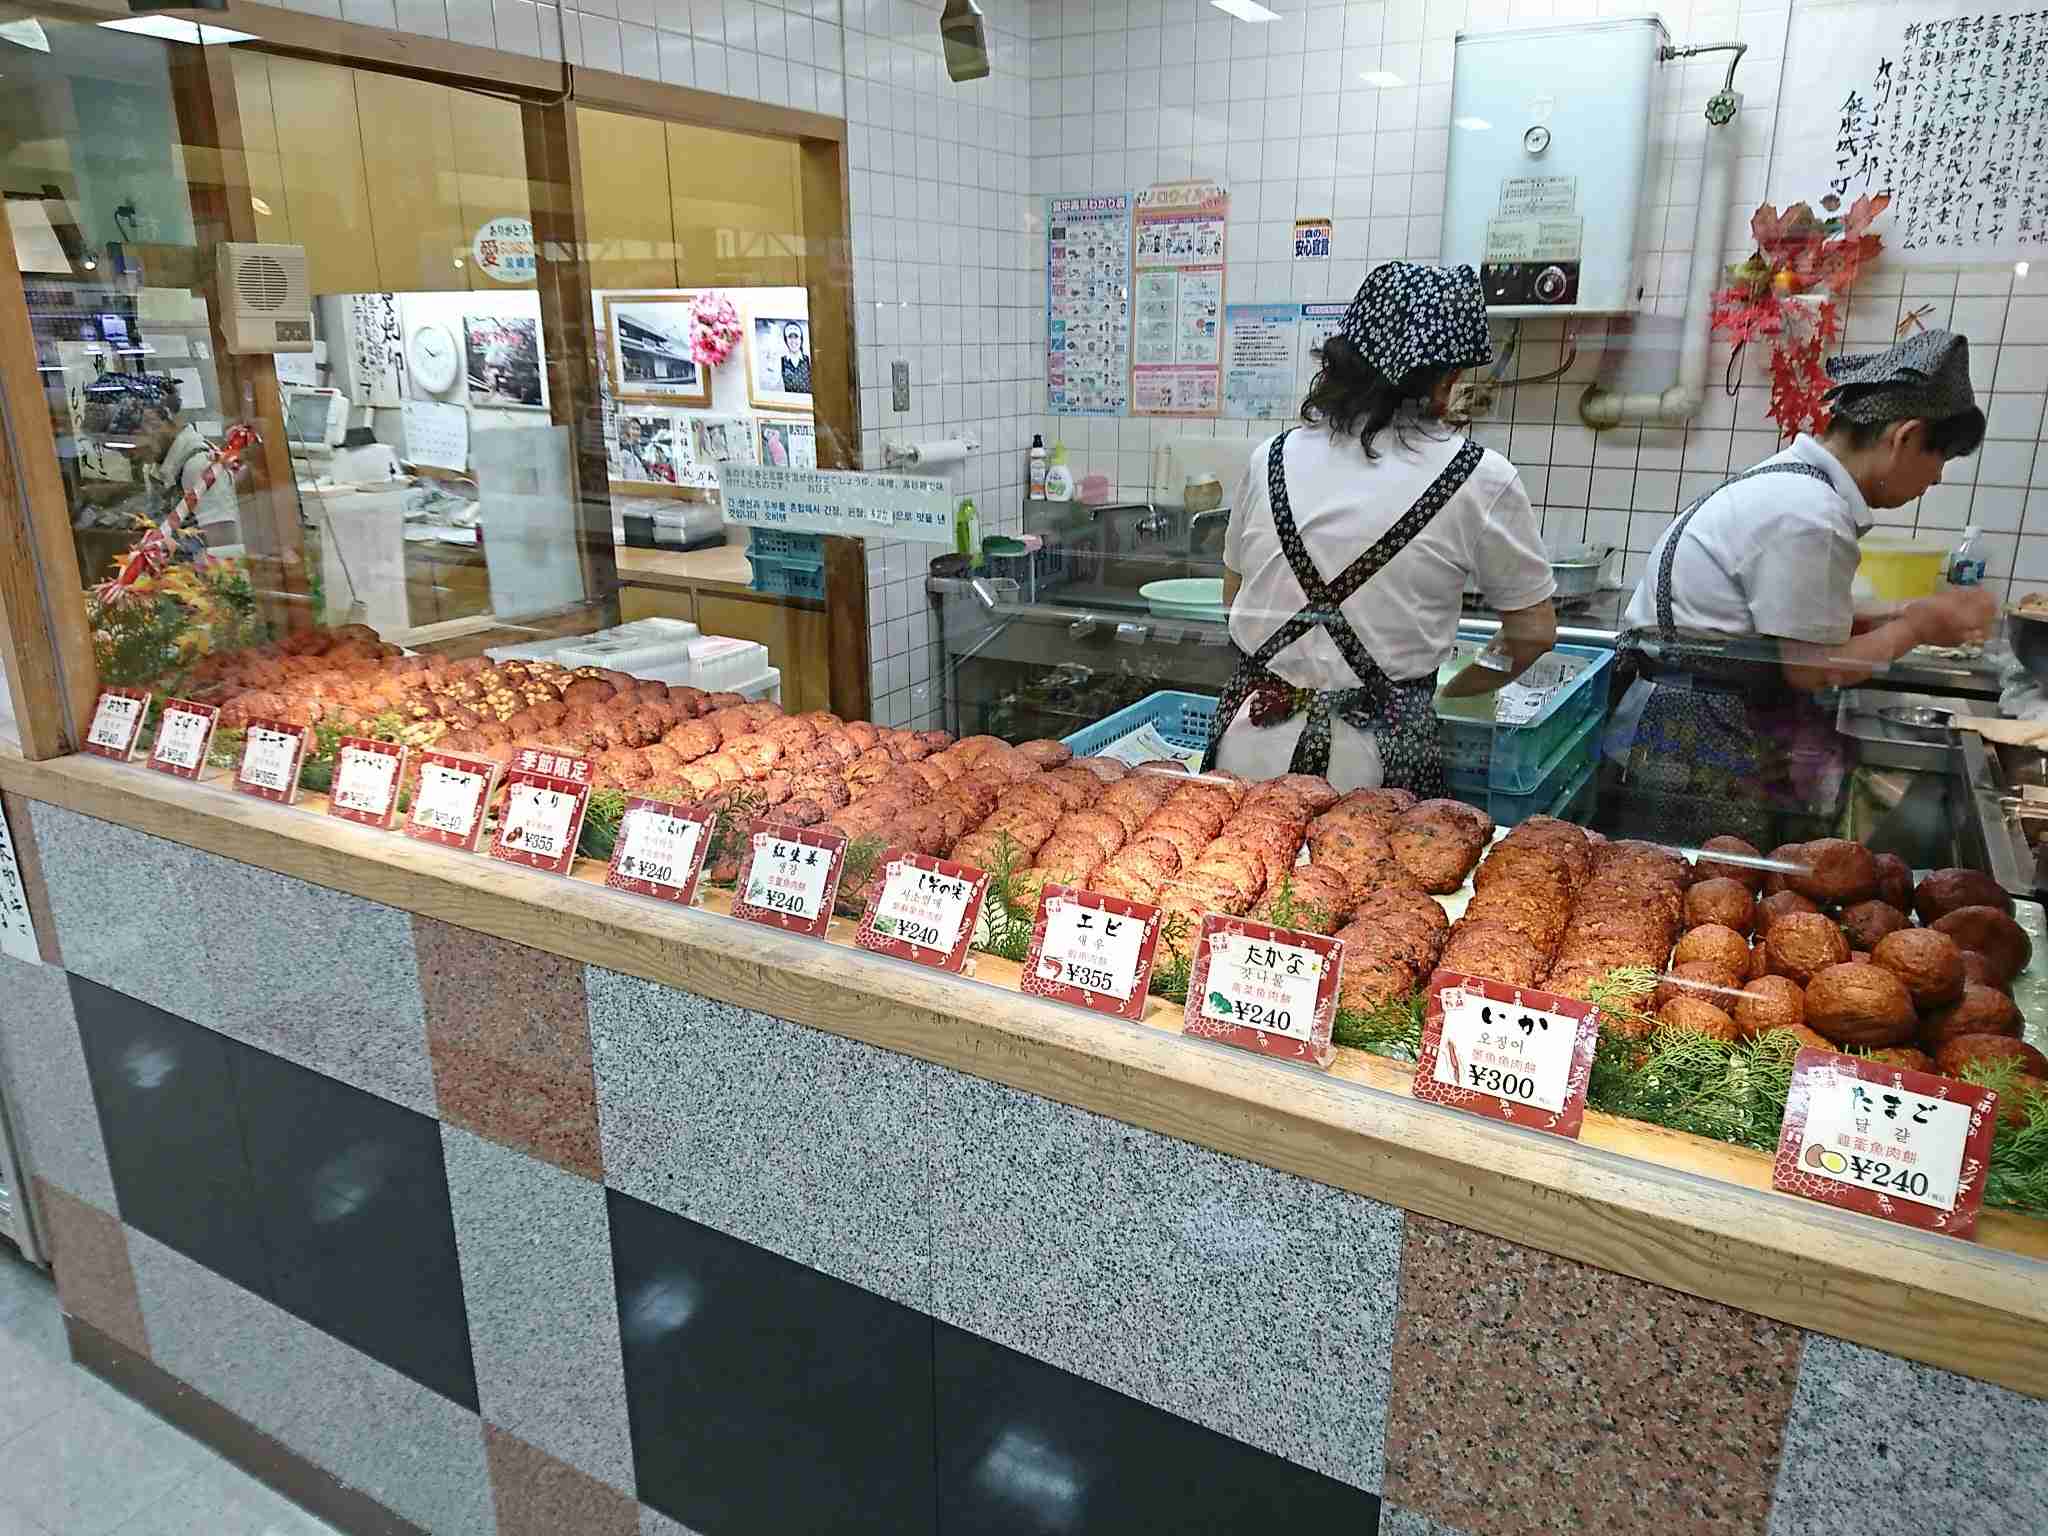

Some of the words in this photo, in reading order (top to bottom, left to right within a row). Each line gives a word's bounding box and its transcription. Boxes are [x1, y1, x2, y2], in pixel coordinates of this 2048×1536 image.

[1854, 57, 1894, 187] 九州の小京都
[1830, 91, 1868, 195] 飫肥城下町
[1295, 238, 1330, 258] 安心宣言
[520, 751, 588, 781] 季節限定
[532, 792, 560, 809] くり
[525, 831, 555, 851] ¥355
[772, 843, 818, 867] 紅生姜
[639, 860, 672, 881] ¥240
[766, 889, 804, 913] ¥240
[919, 873, 966, 901] しその実
[897, 919, 939, 945] ¥240
[1076, 913, 1122, 937] エビ
[1244, 944, 1305, 976] たかな
[1066, 963, 1114, 991] ¥355
[1234, 1000, 1291, 1031] ¥240
[1481, 1006, 1549, 1036] いか
[1469, 1063, 1535, 1099] ¥300
[1851, 1085, 1939, 1125] たまご
[1850, 1155, 1929, 1197] ¥240
